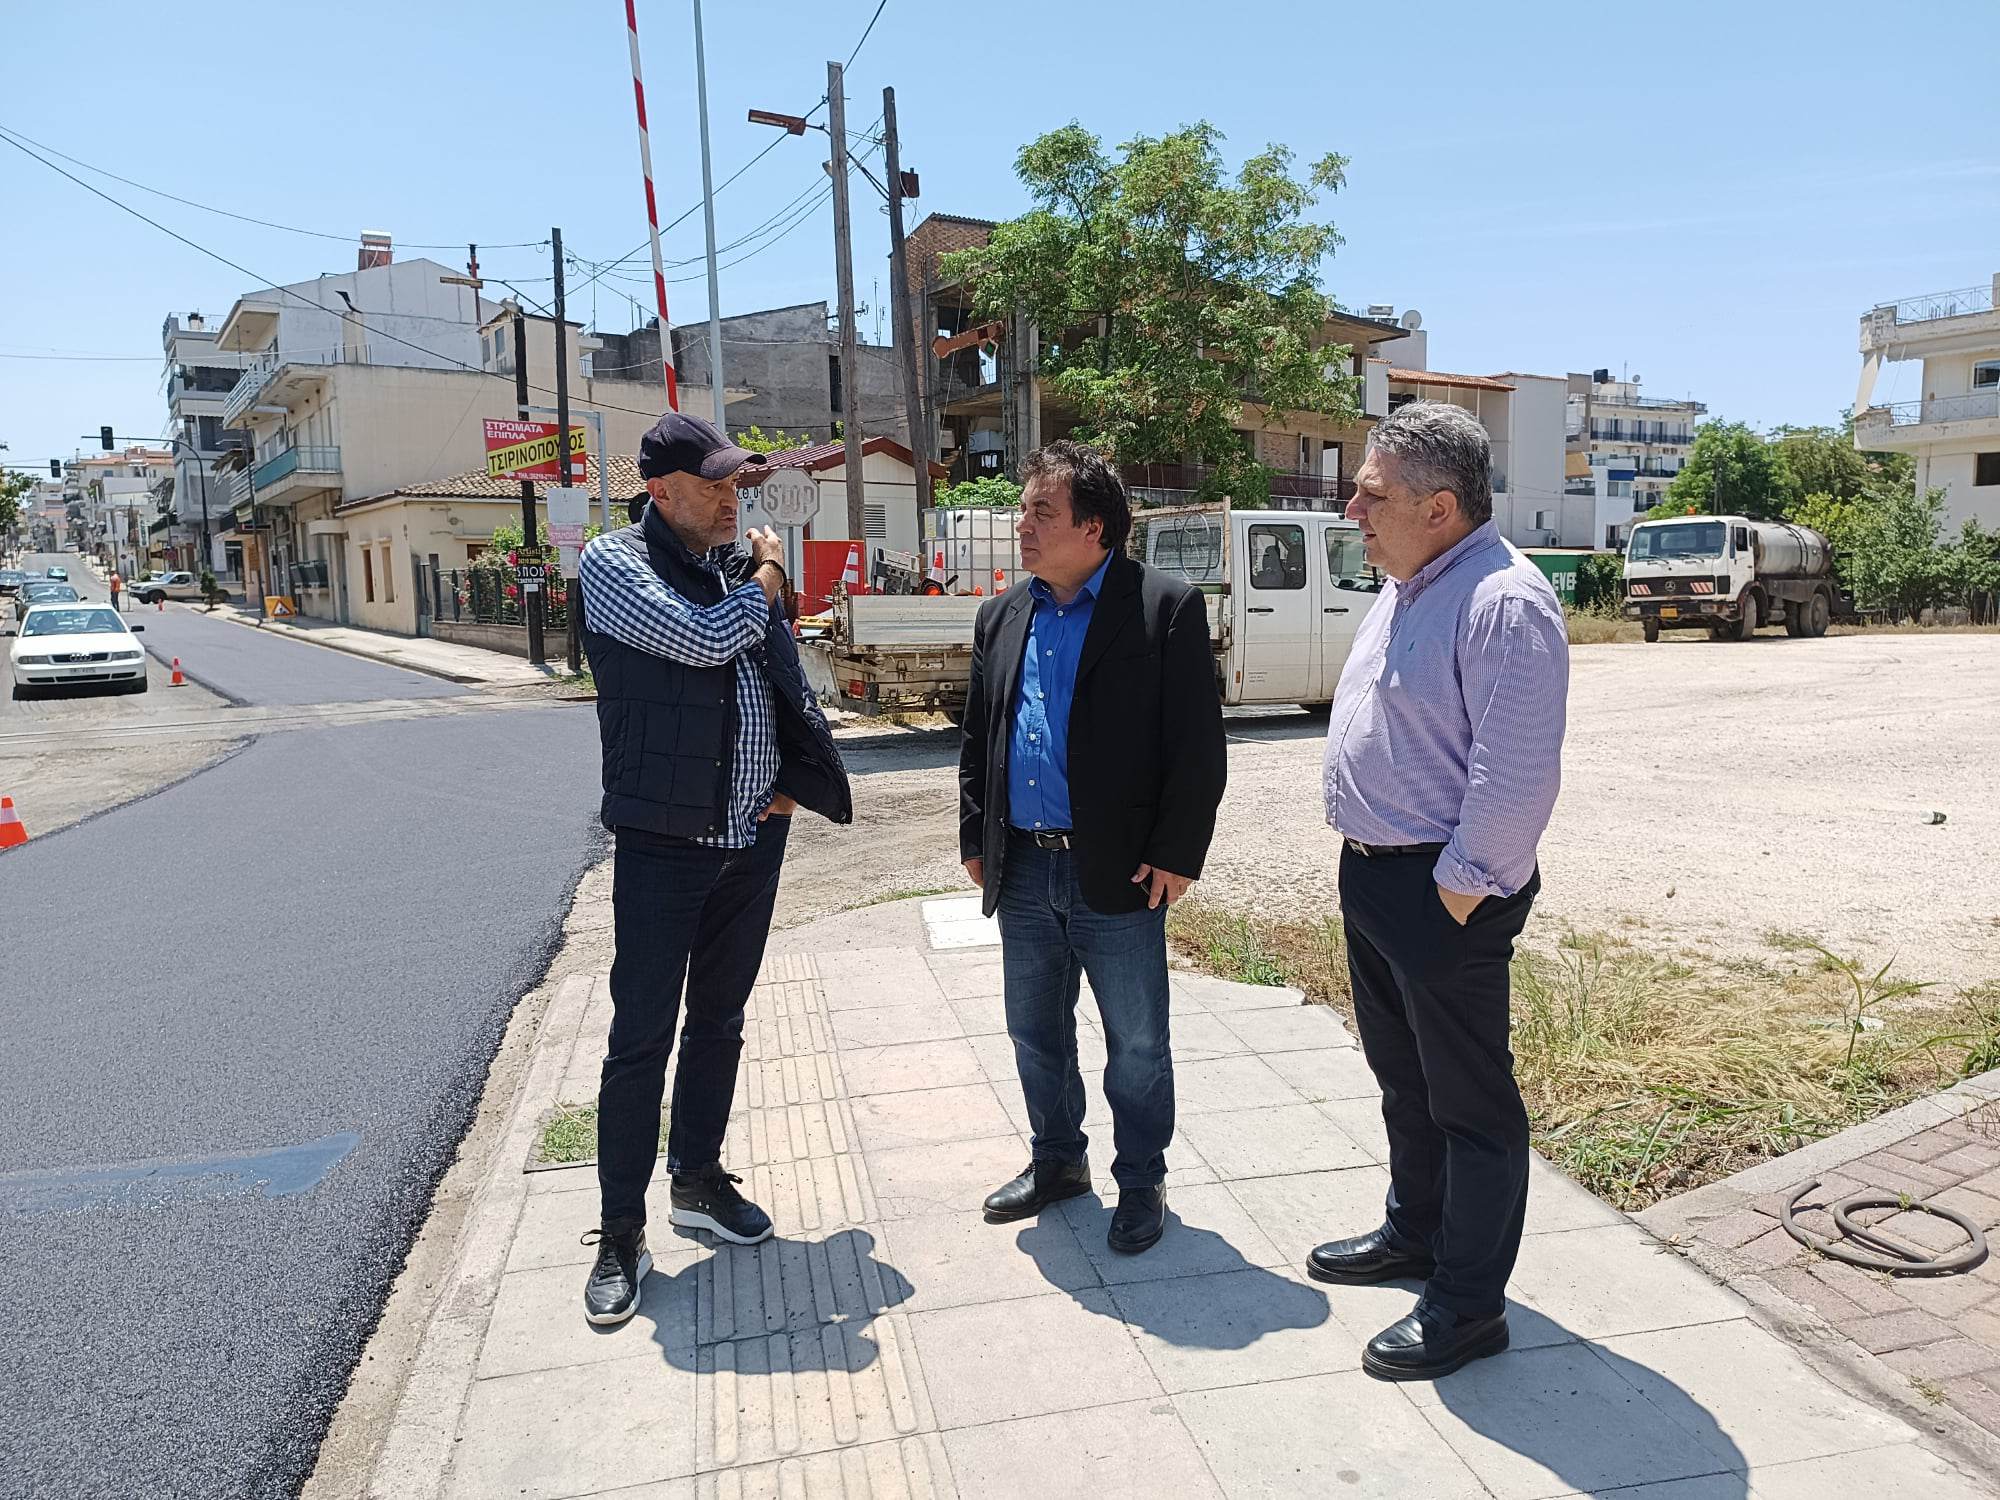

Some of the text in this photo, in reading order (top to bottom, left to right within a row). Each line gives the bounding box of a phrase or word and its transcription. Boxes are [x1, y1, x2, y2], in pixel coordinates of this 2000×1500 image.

[485, 421, 544, 433] ΣΤΡΩΜΑΤΑ
[487, 431, 526, 440] ΕΠΙΠΛΑ
[489, 432, 585, 473] ΤΣΙΡΙΝΟΠΟΥΟΣ
[767, 483, 814, 513] STOP
